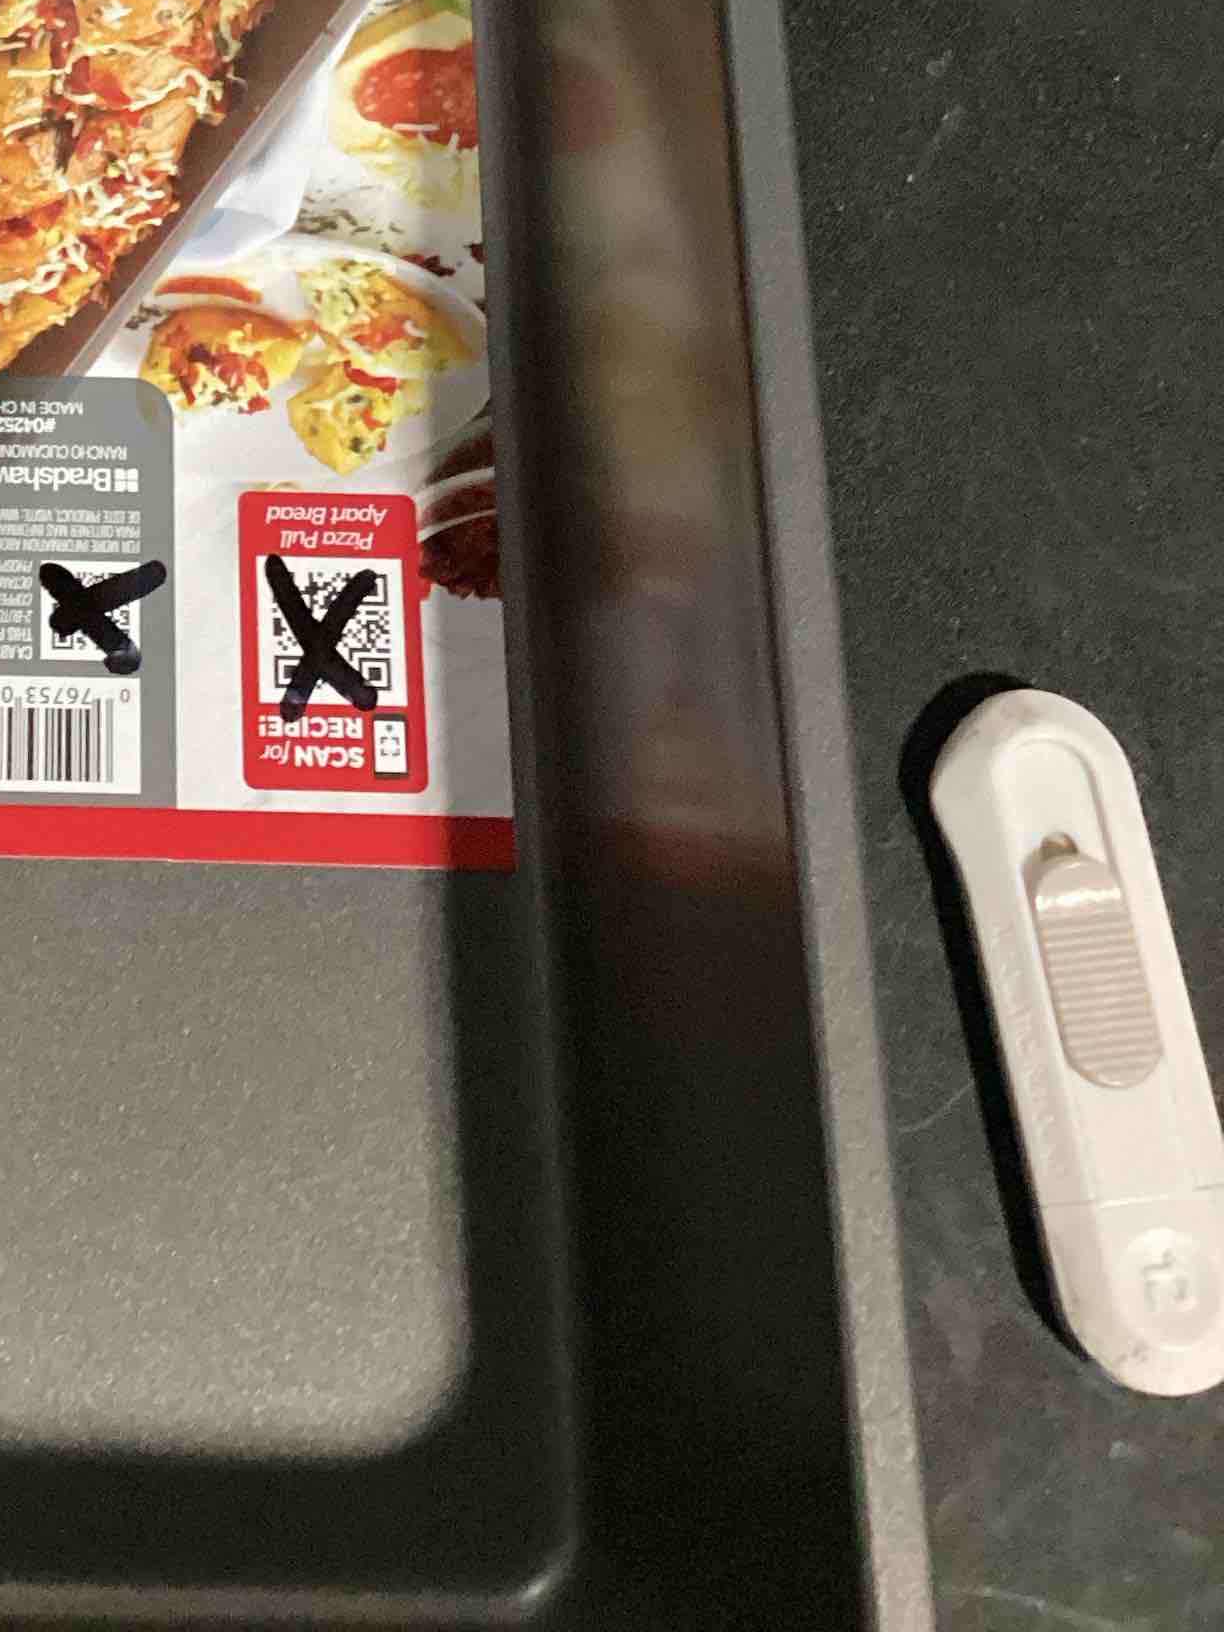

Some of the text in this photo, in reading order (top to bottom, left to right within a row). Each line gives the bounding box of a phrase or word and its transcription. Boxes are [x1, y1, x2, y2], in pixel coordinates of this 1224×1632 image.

[20, 401, 36, 414] IN
[40, 401, 84, 415] MADE
[71, 445, 127, 460] RANCHO
[265, 504, 387, 527] Apart Bread
[280, 530, 374, 550] Pizza Pull
[26, 686, 91, 705] 76753
[258, 715, 364, 739] RECIPE!
[259, 741, 365, 769] SCAN for
